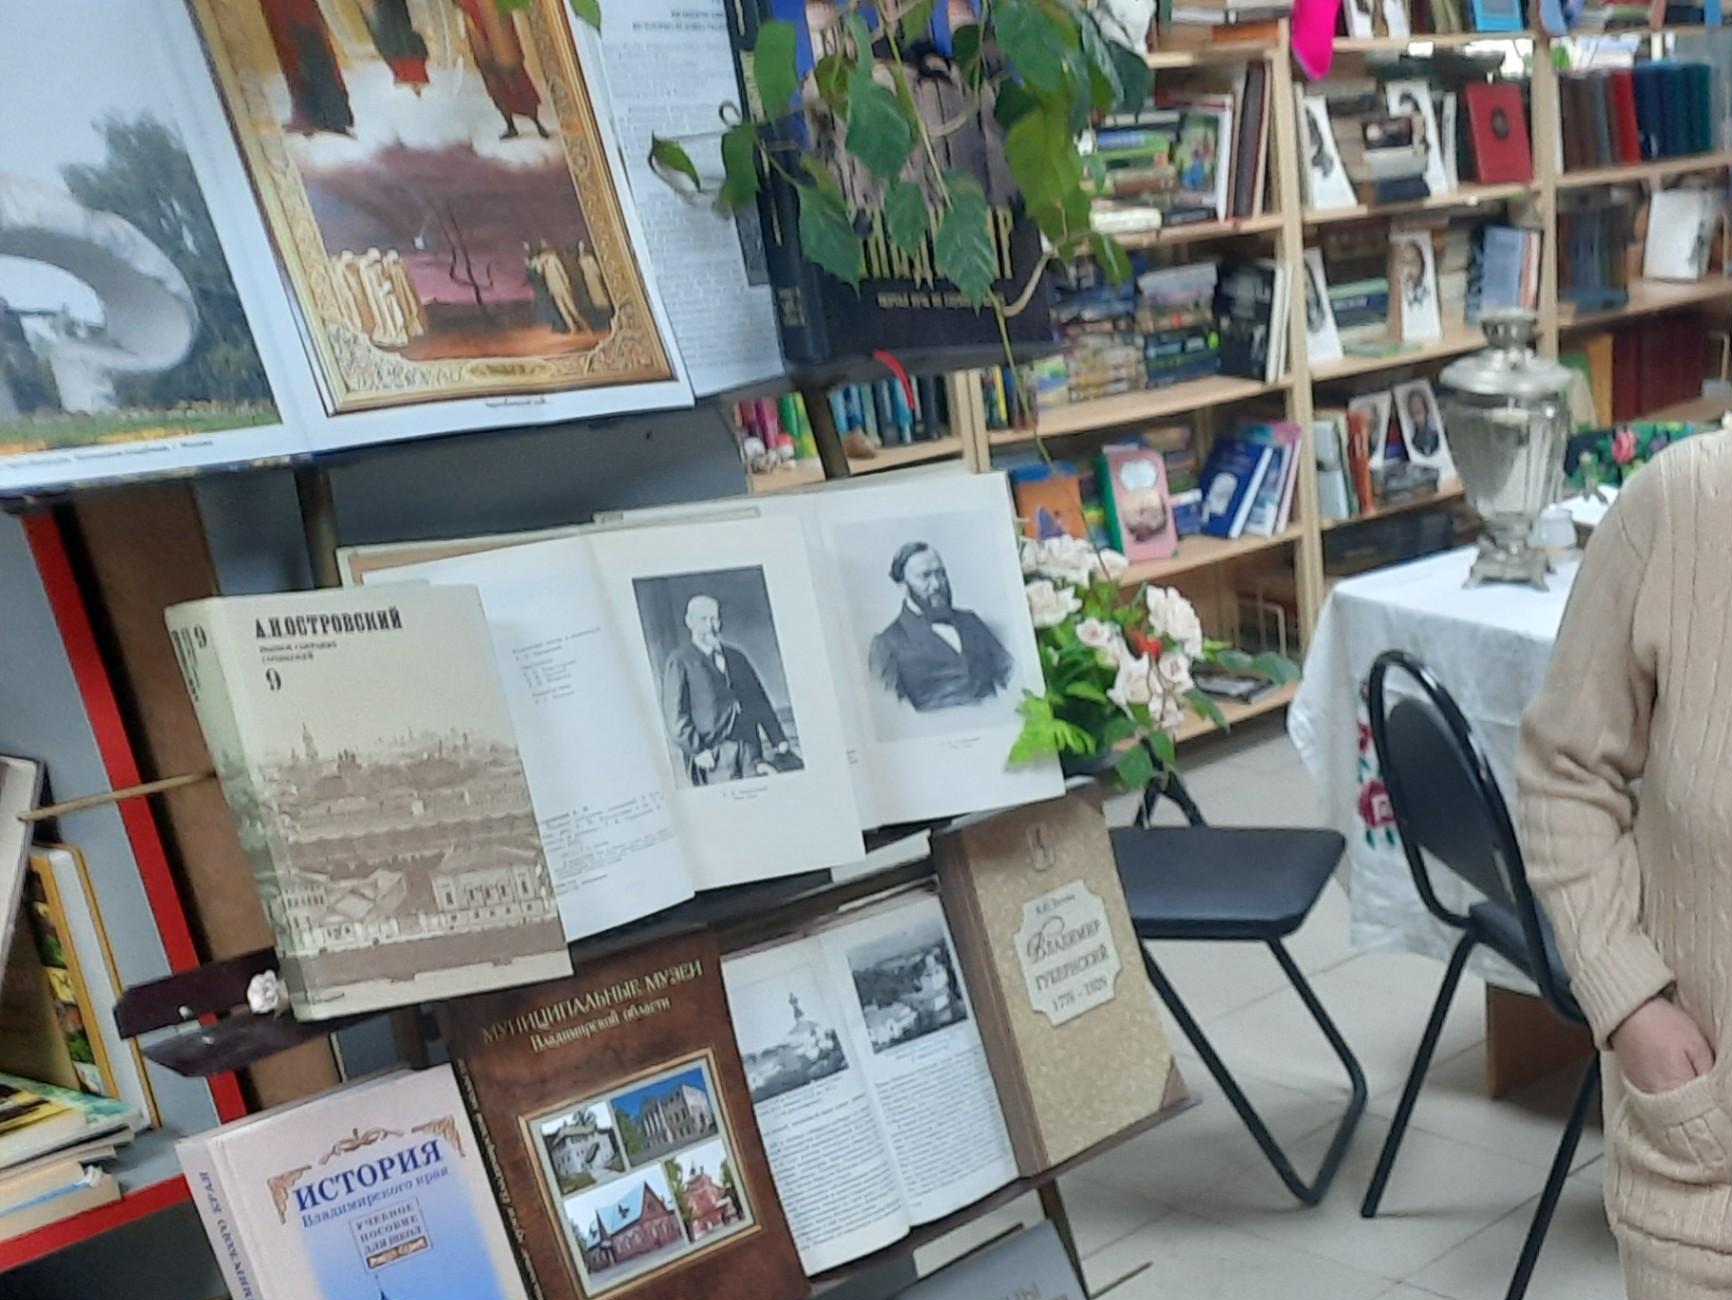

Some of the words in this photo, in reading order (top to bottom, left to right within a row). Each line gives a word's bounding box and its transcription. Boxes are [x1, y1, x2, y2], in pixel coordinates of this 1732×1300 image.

[265, 667, 282, 692] 9
[481, 977, 641, 1045] МУНИЦИПАЛЬНЫЕ
[646, 959, 704, 992] МУЗЕИ
[293, 1139, 443, 1211] ИСТОРИЯ
[302, 1180, 414, 1228] Владимирского
[416, 1166, 449, 1190] края
[355, 1202, 416, 1231] УЧЕБНОЕ
[360, 1215, 420, 1243] ПОСОБИЕ
